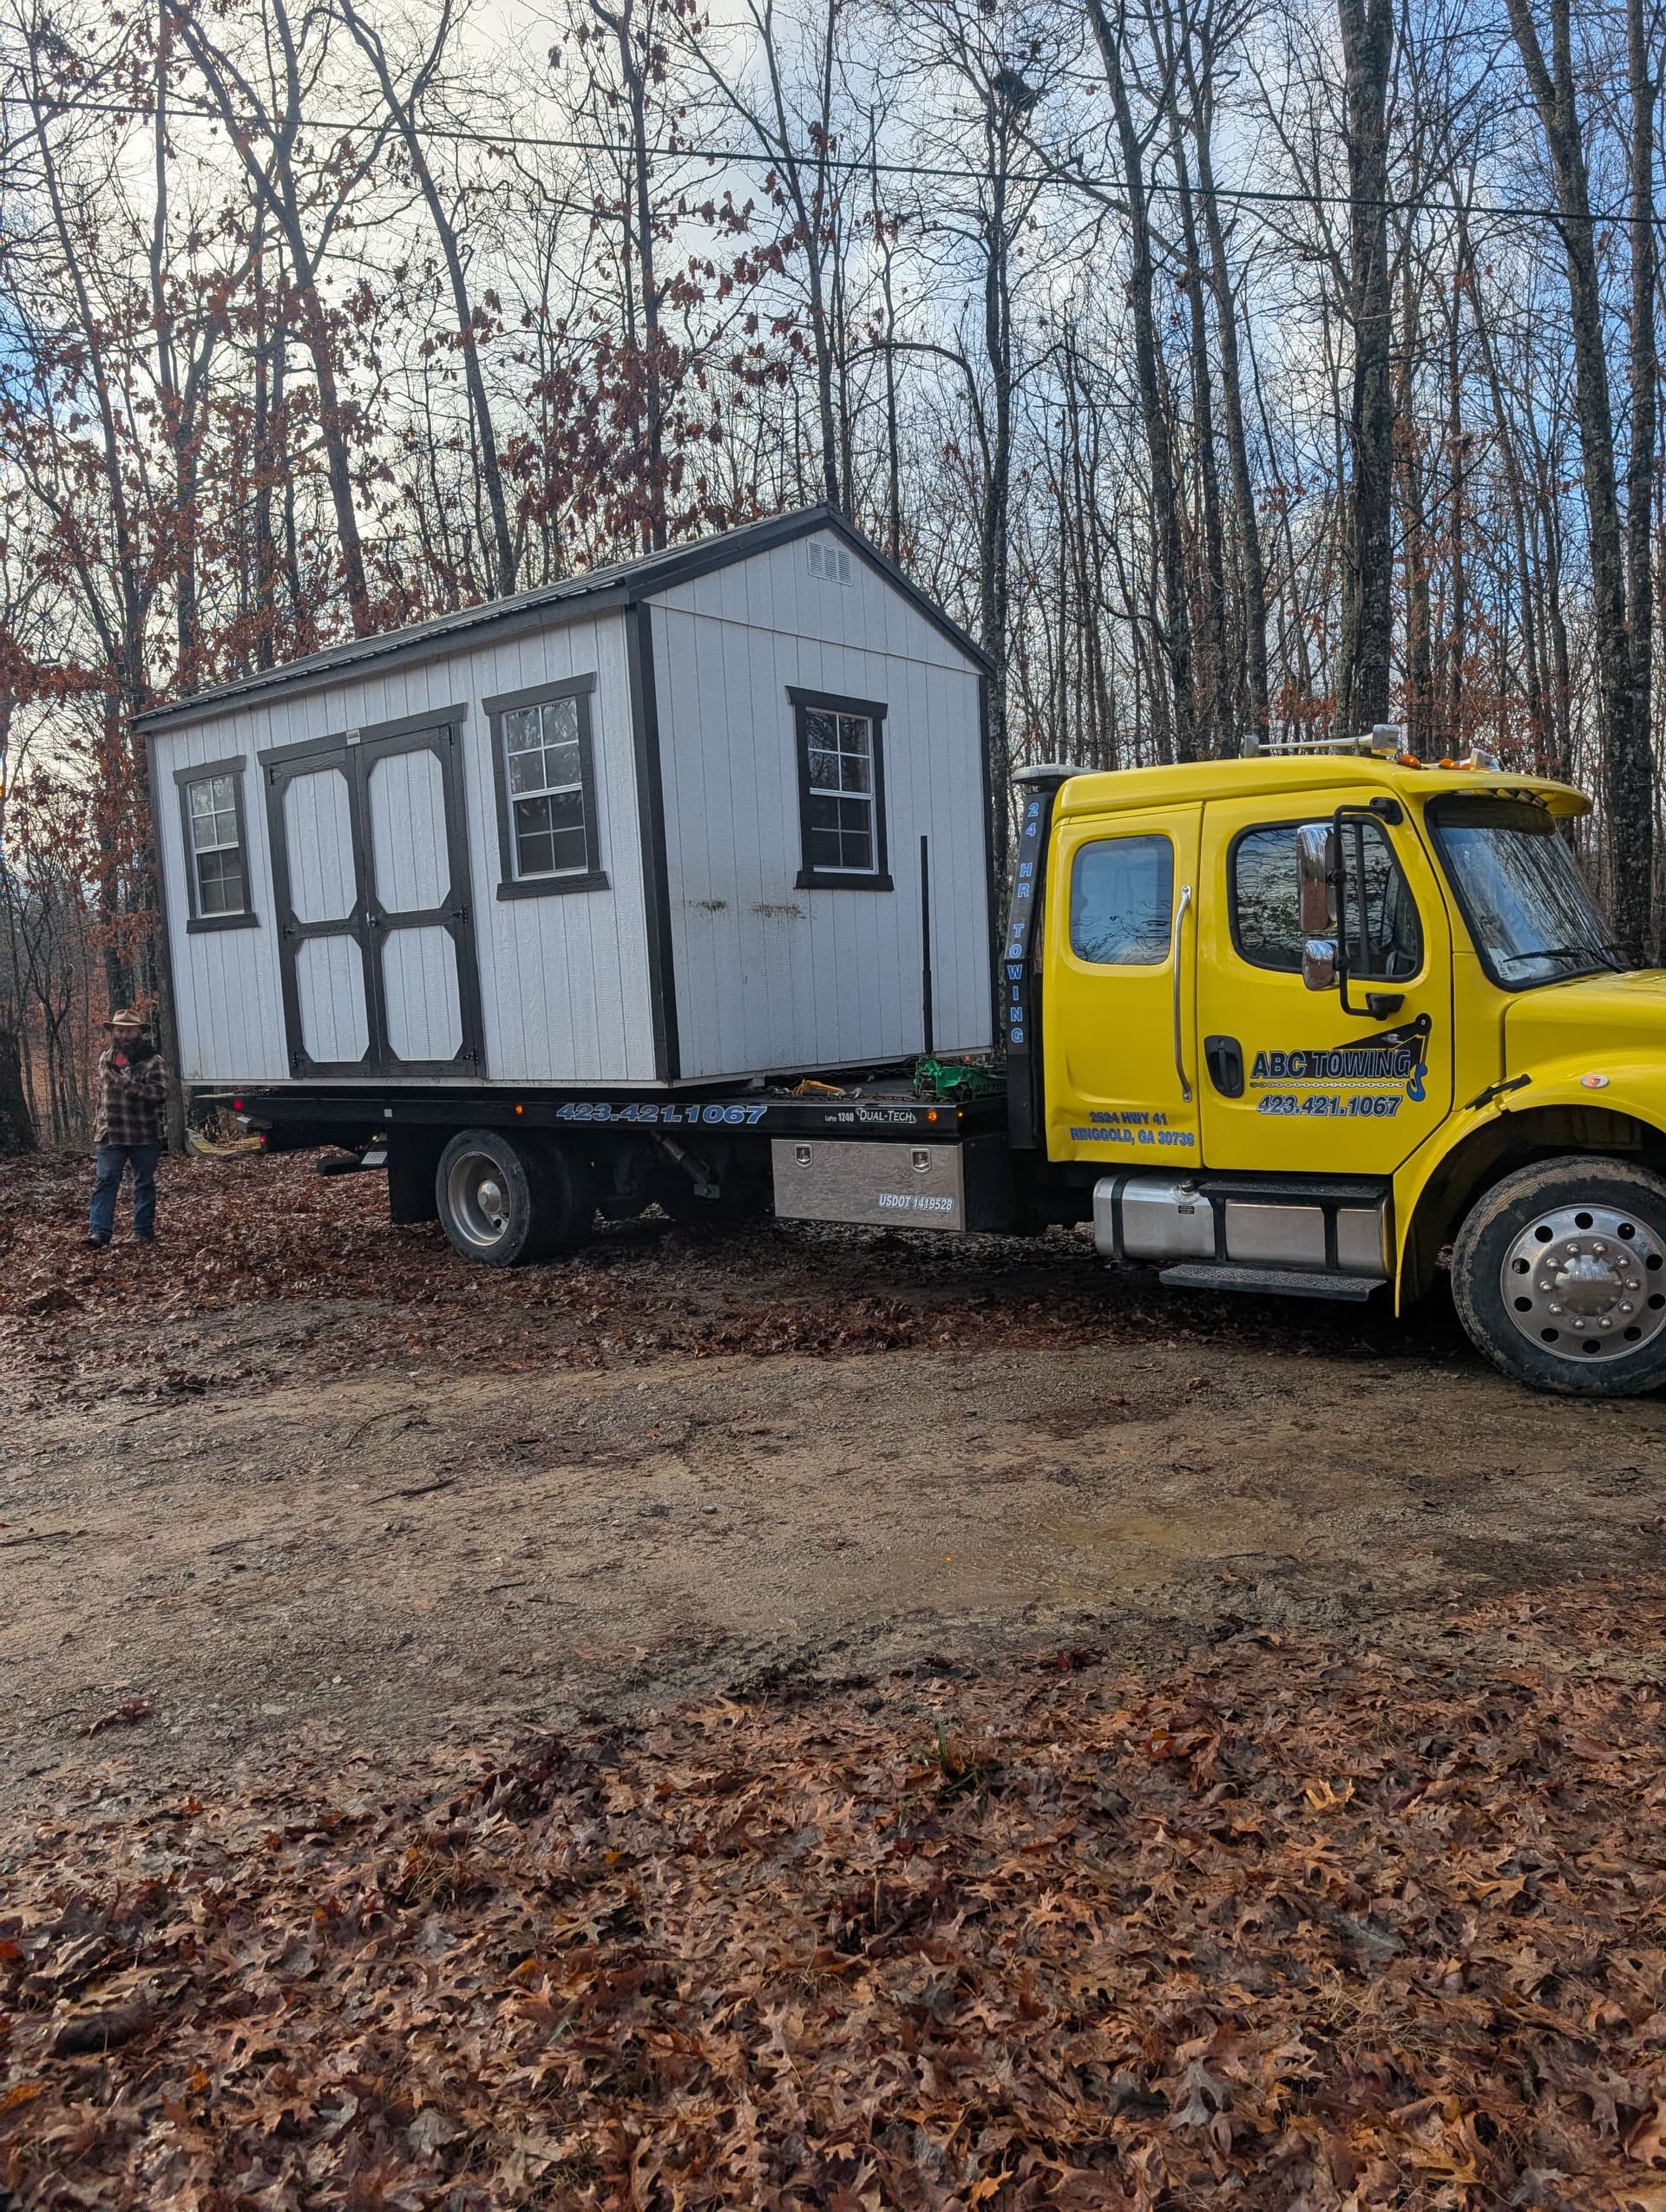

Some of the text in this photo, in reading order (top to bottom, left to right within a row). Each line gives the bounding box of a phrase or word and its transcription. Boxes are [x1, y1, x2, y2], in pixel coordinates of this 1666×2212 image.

[1007, 802, 1040, 1044] 24 HR TOWING
[1250, 1048, 1411, 1078] ABC TOWING
[556, 1103, 768, 1124] 423.421.1067
[1256, 1094, 1402, 1116] 423.421.1067
[838, 1112, 855, 1122] 1240
[1121, 1111, 1150, 1125] HWY
[1152, 1113, 1168, 1126] 41
[1069, 1127, 1195, 1146] RINGGOLD, GA 30736
[879, 1194, 954, 1212] USDOT 1419528
